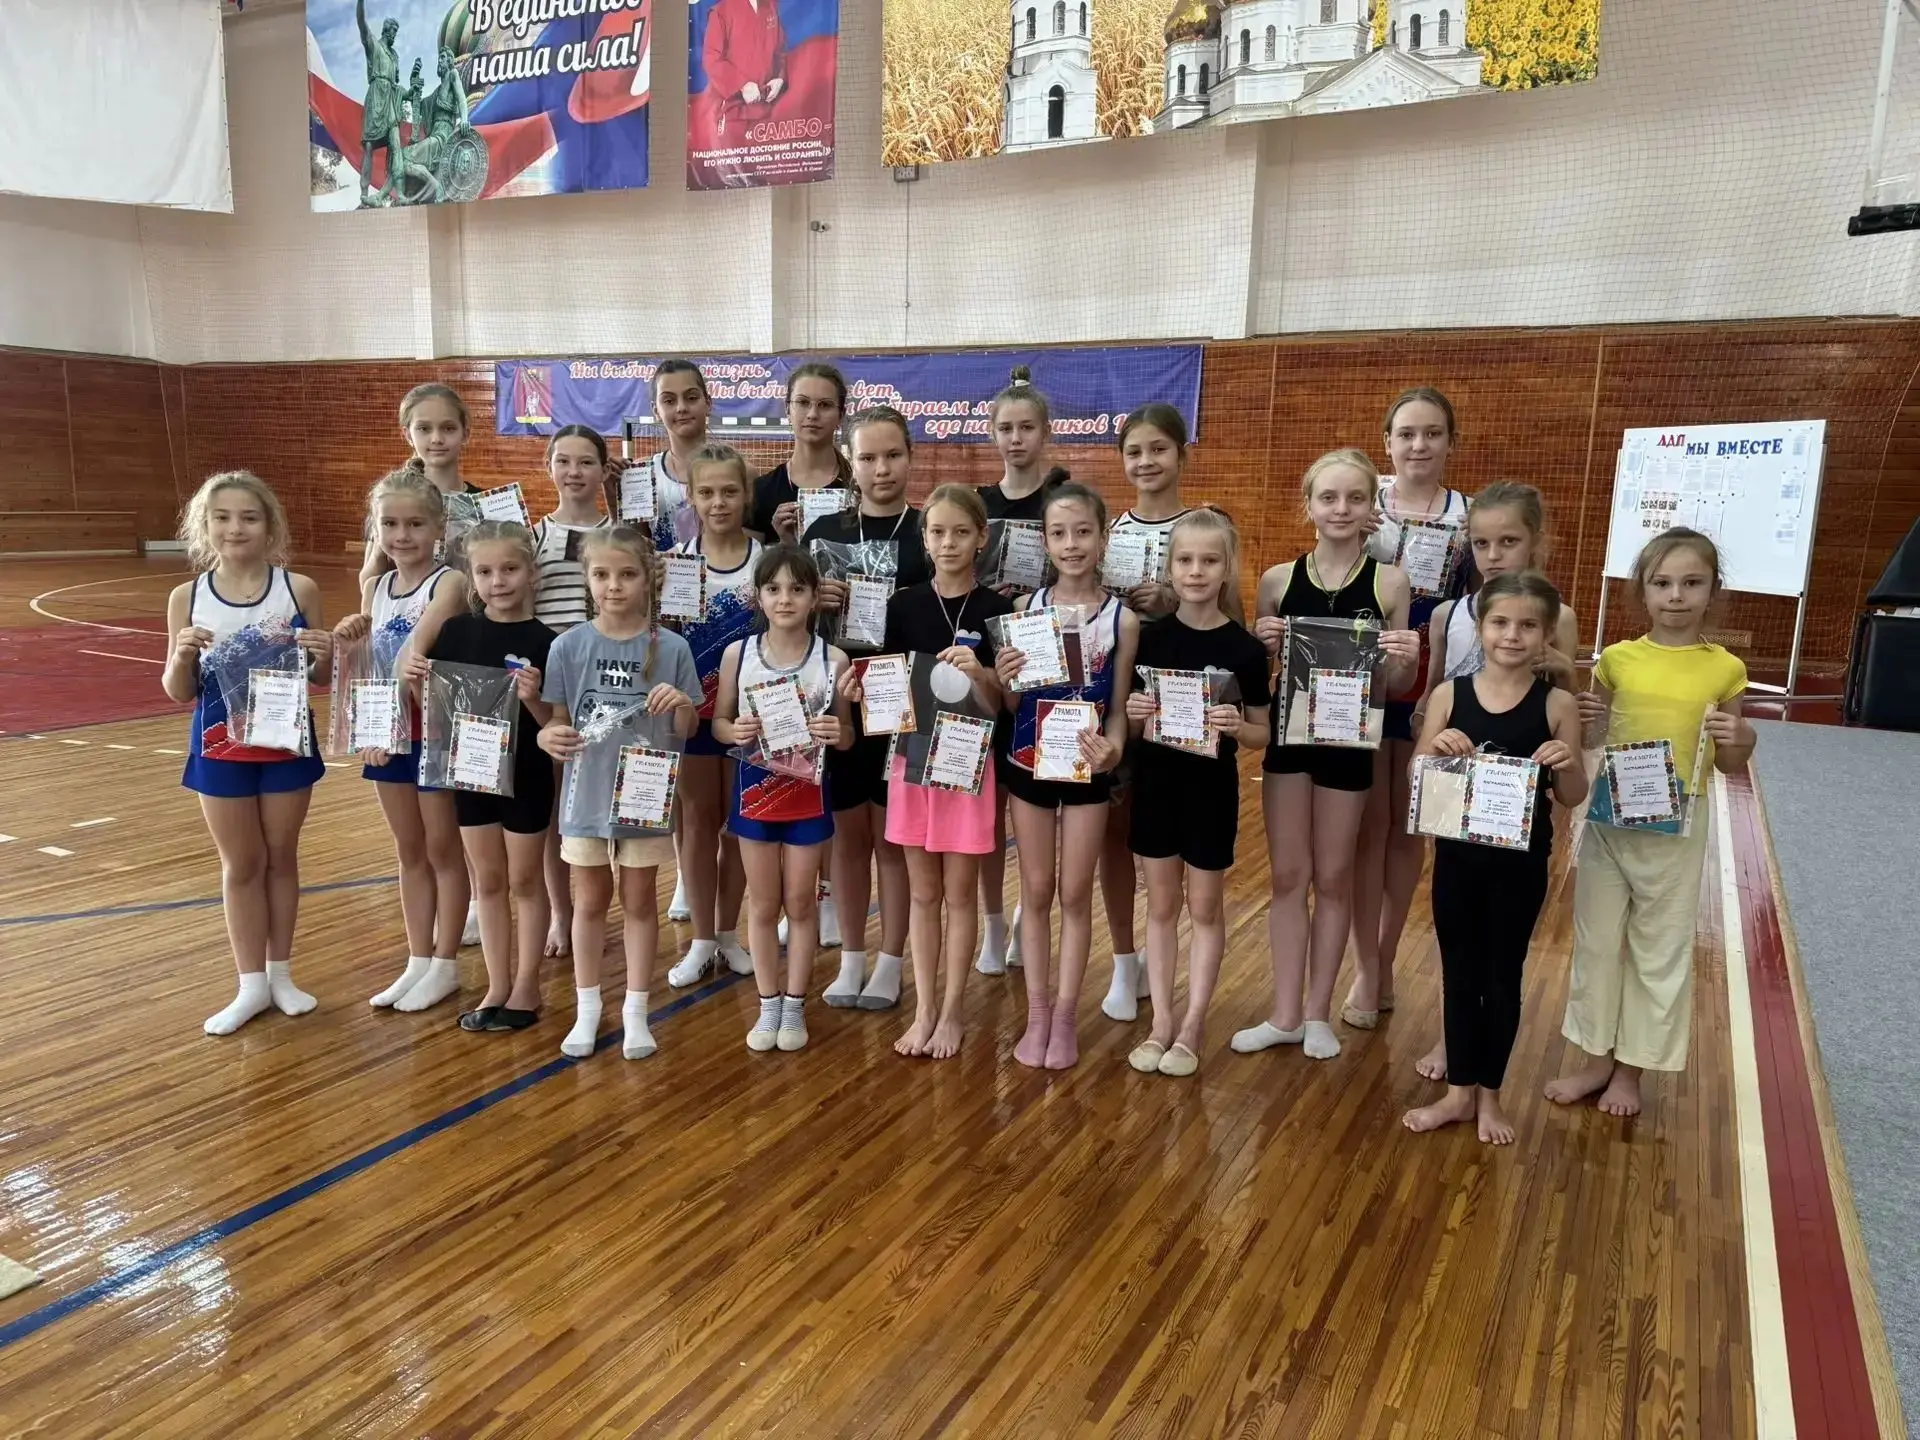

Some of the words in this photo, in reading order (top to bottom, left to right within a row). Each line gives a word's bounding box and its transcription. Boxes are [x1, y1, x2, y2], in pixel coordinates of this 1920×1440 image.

[471, 46, 551, 86] наша
[556, 20, 643, 74] сила!
[692, 146, 748, 159] НАЦИОНАЛЬНОЕ
[750, 142, 790, 154] ДОСТОЯНИЕ
[717, 157, 741, 166] НУЖНО
[743, 155, 773, 163] ЛЮБИТЬ
[569, 361, 597, 378] Мы
[600, 360, 657, 382] выбир
[706, 381, 735, 398] Мы
[736, 380, 788, 398] выби
[925, 419, 961, 439] где
[1685, 442, 1710, 455] МЫ
[1716, 438, 1783, 456] ВМЕСТЕ
[595, 658, 641, 674] HAVE
[870, 661, 896, 671] ГРАМОТА
[599, 674, 633, 688] FUN
[1053, 707, 1082, 717] ГРАМОТА
